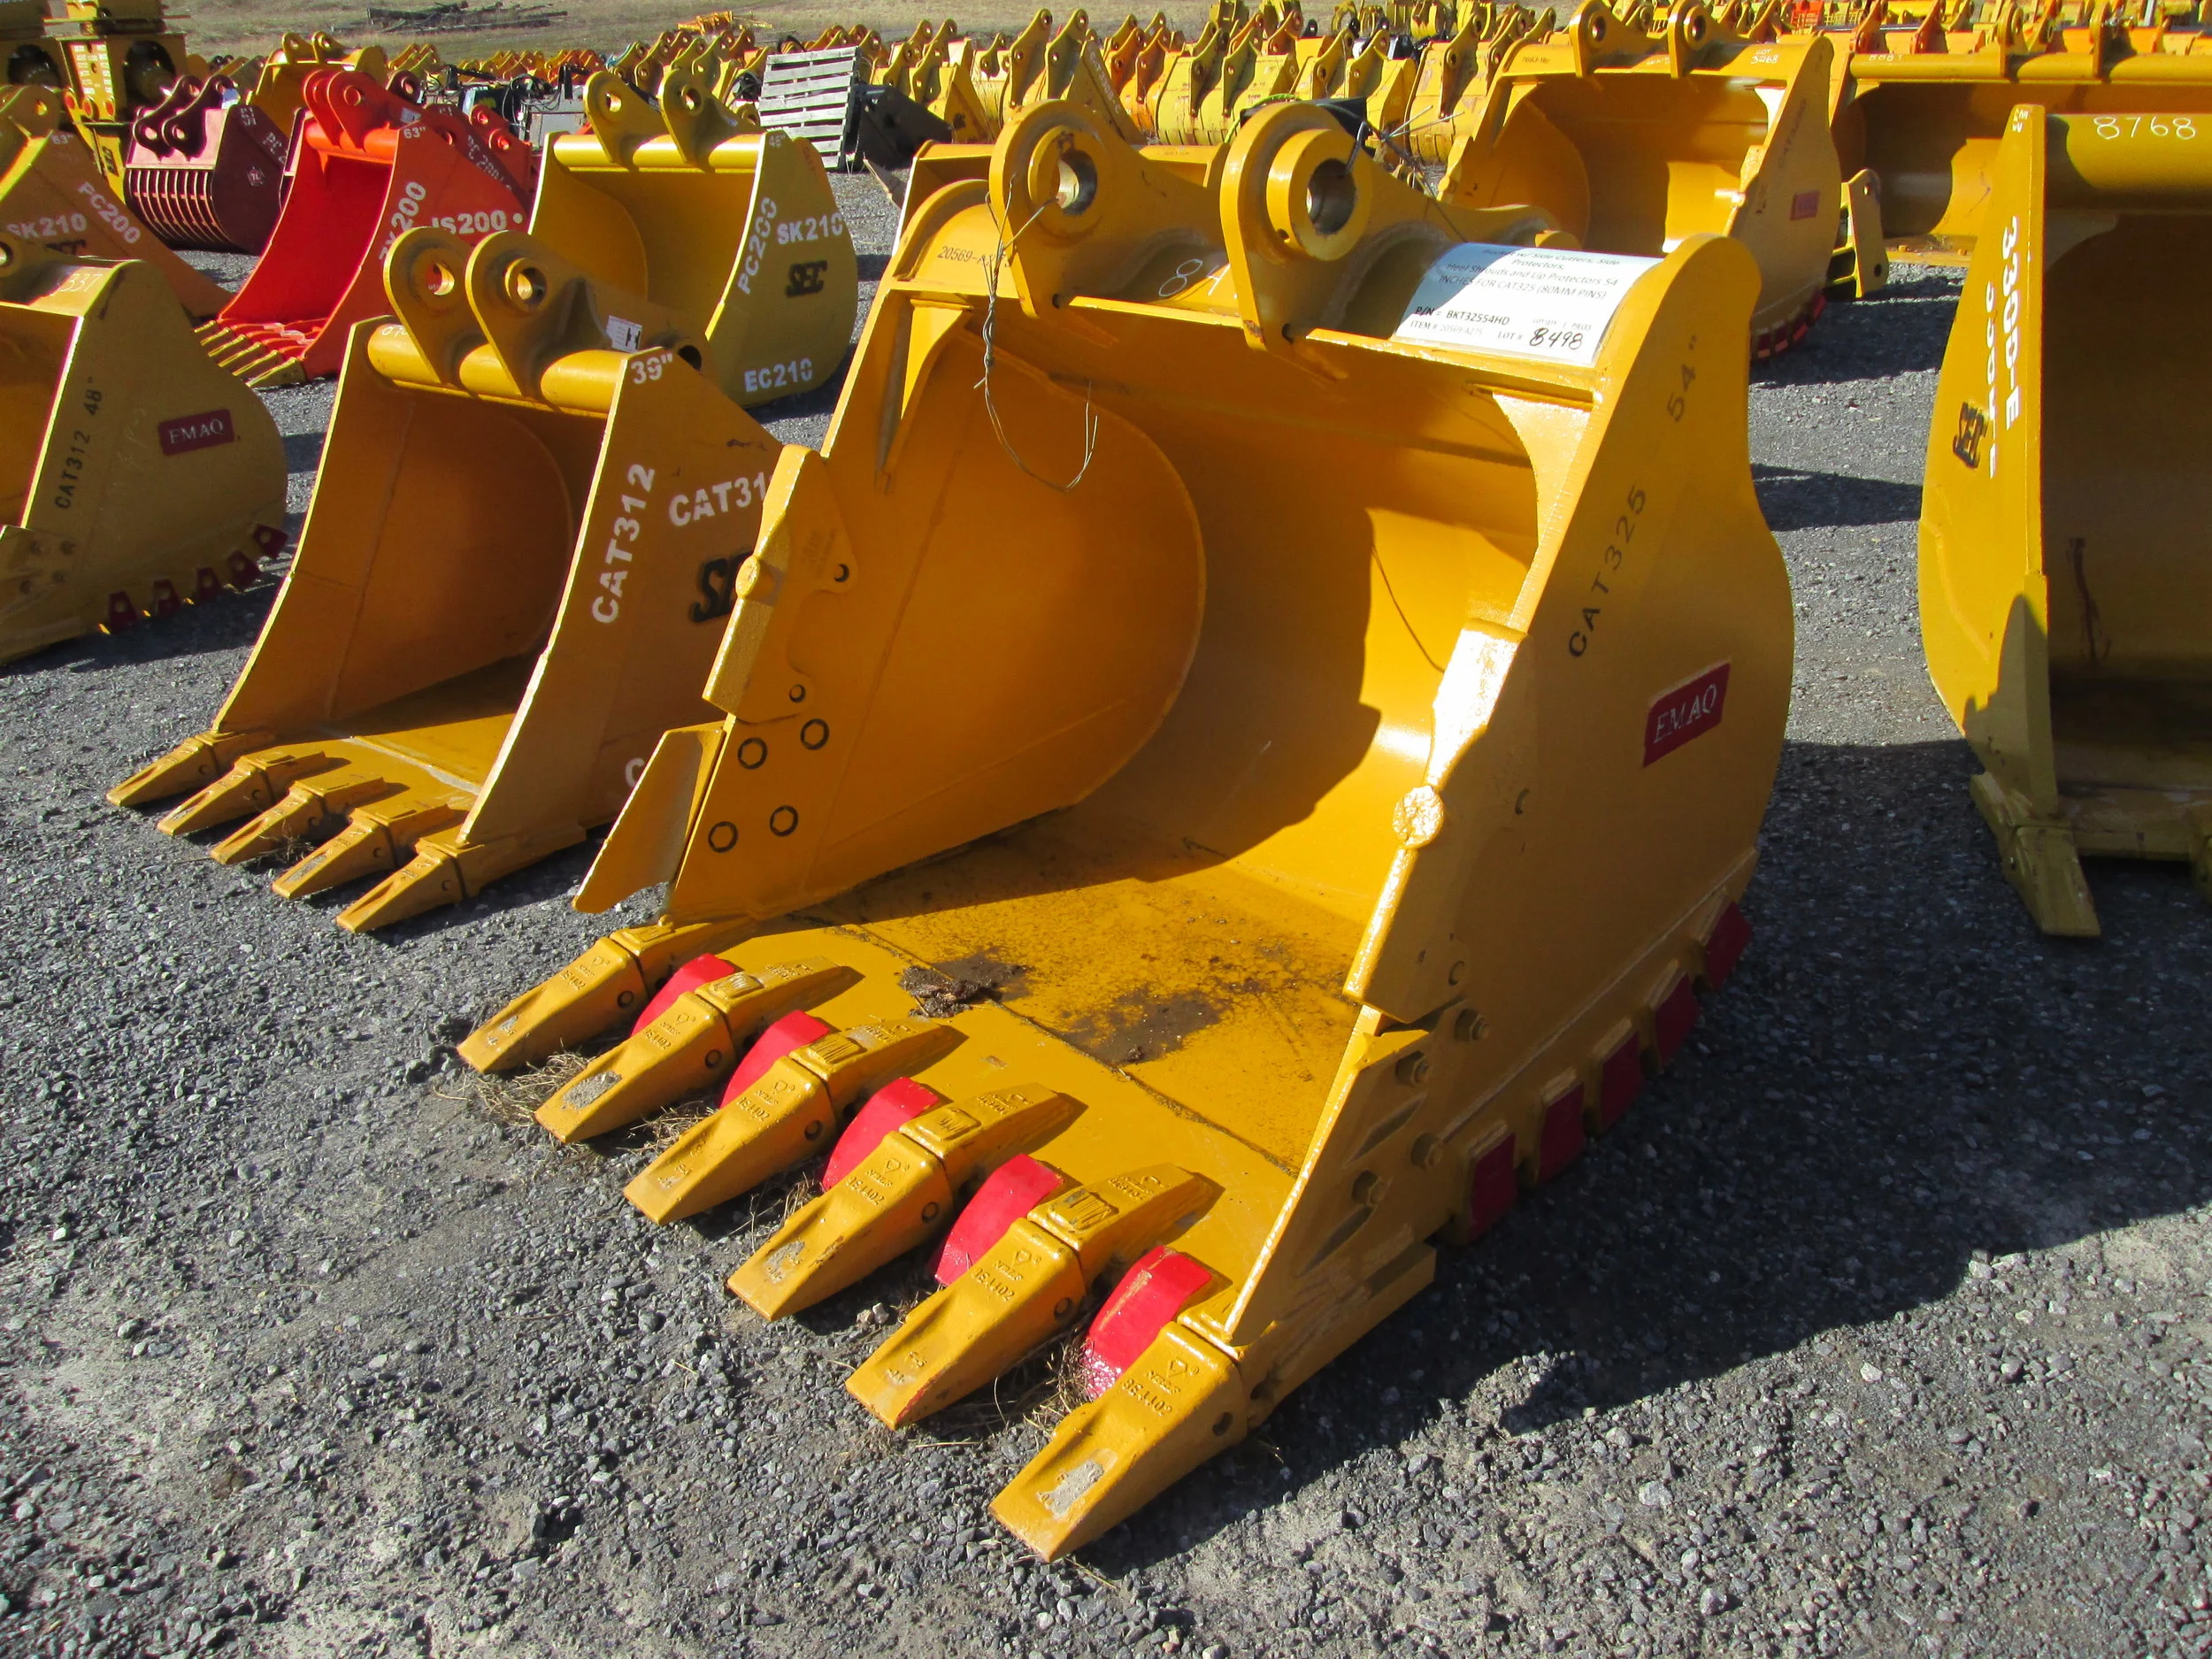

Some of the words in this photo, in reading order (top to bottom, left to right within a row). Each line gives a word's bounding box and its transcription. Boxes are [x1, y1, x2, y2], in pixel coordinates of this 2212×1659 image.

[1750, 54, 1779, 65] 3268
[403, 126, 426, 139] 63"
[2093, 116, 2196, 140] 8768
[78, 181, 142, 243] PC200
[776, 211, 843, 245] SK210
[737, 197, 778, 295] PC200
[1438, 274, 1473, 286] INCHES
[1474, 278, 1497, 288] FOR
[1497, 280, 1536, 292] CAT325
[1536, 283, 1577, 296] (80MM
[1577, 288, 1607, 301] PINS)
[1469, 265, 1508, 276] Shrouds
[1509, 269, 1531, 278] and
[1548, 273, 1601, 285] Protectors
[1603, 277, 1619, 287] 54
[1415, 305, 1435, 317] P/N
[1446, 310, 1510, 326] BKT32554HD
[1410, 319, 1432, 330] ITEM
[1497, 331, 1517, 341] LOT
[1529, 326, 1584, 350] 8498
[630, 352, 674, 385] 39"
[744, 357, 813, 393] EC210
[54, 430, 91, 511] CAT312
[668, 472, 772, 527] CAT31
[592, 463, 656, 625] CAT312
[1568, 484, 1647, 658] CAT325
[1653, 684, 1718, 744] EMAQ
